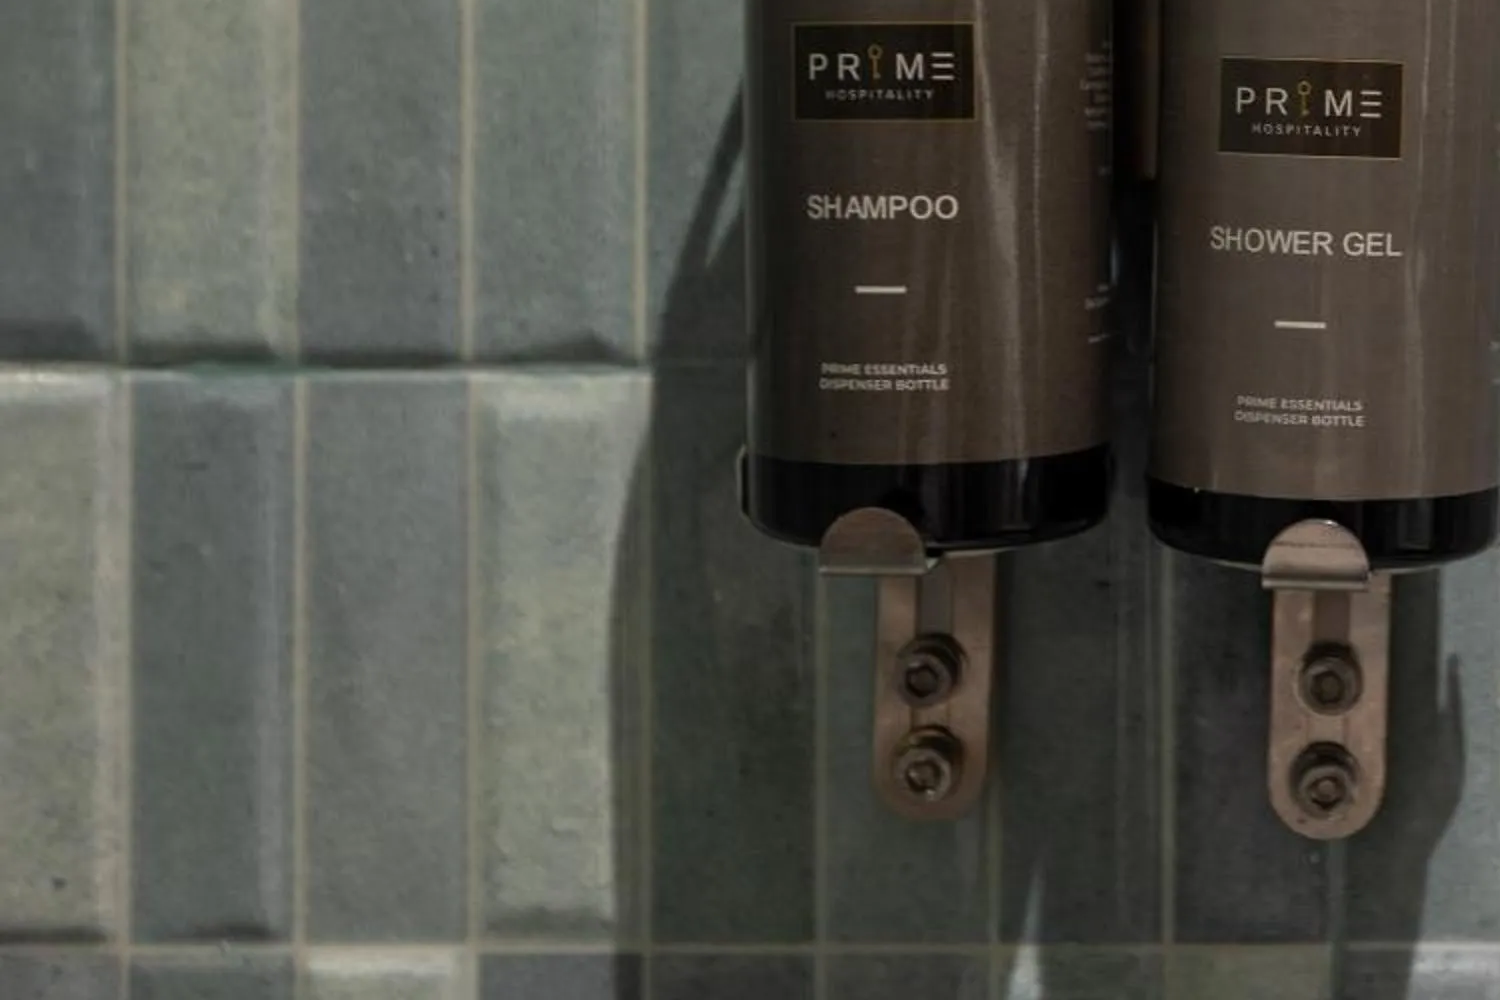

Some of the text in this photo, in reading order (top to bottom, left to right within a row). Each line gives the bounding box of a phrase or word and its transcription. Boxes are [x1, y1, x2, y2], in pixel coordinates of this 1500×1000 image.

[808, 44, 955, 81] PRIME
[824, 88, 935, 101] HOSPITALITY
[1235, 81, 1383, 119] PRIME
[1251, 122, 1363, 138] HOSPITALITY
[807, 194, 959, 221] SHAMPOO
[1210, 226, 1404, 258] SHOWER GEL
[820, 361, 948, 376] PRIME ESSENTIALS
[819, 376, 951, 391] DISPENSER BOTTLE
[1236, 395, 1364, 412] PRIME ESSENTIALS
[1234, 410, 1366, 428] DISPENSER BOTTLE
